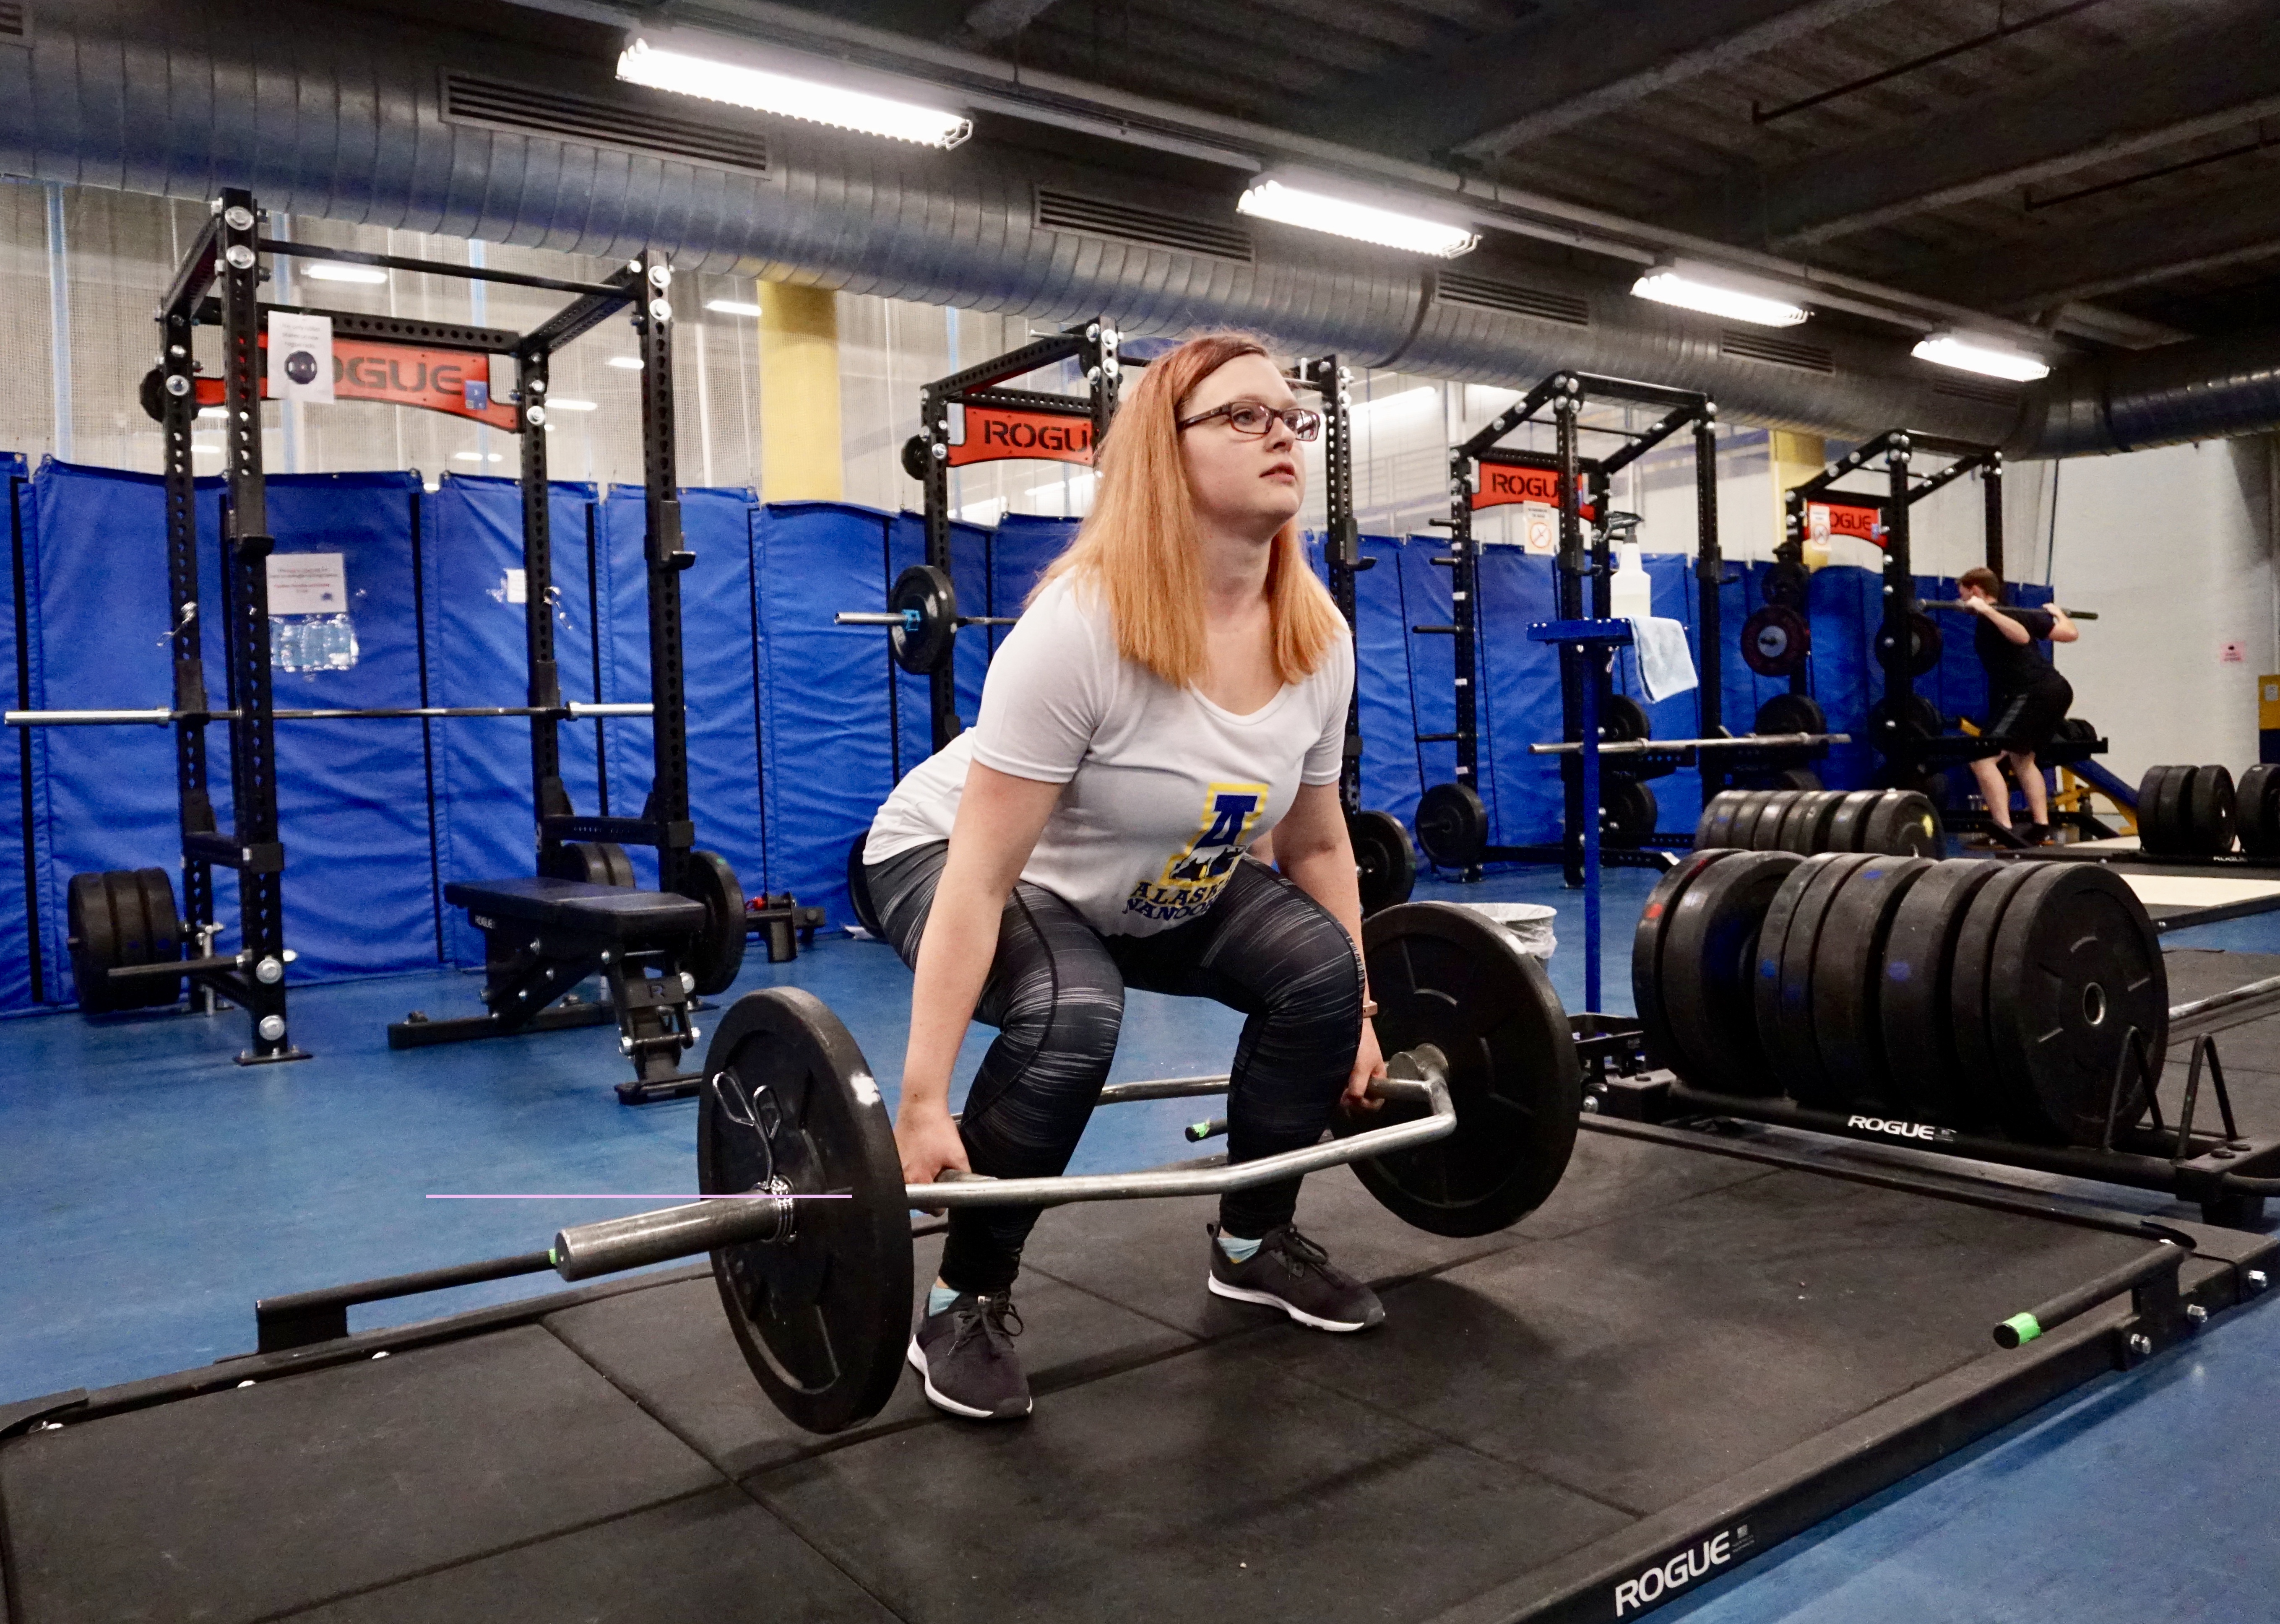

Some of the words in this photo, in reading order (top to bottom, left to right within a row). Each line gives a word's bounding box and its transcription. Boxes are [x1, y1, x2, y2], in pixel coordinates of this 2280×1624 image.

[984, 419, 1091, 452] ROGU
[1492, 472, 1559, 498] ROGU
[1830, 512, 1871, 531] OGUE
[1848, 1115, 1935, 1141] ROGUE
[1615, 1530, 1731, 1617] ROGUE
